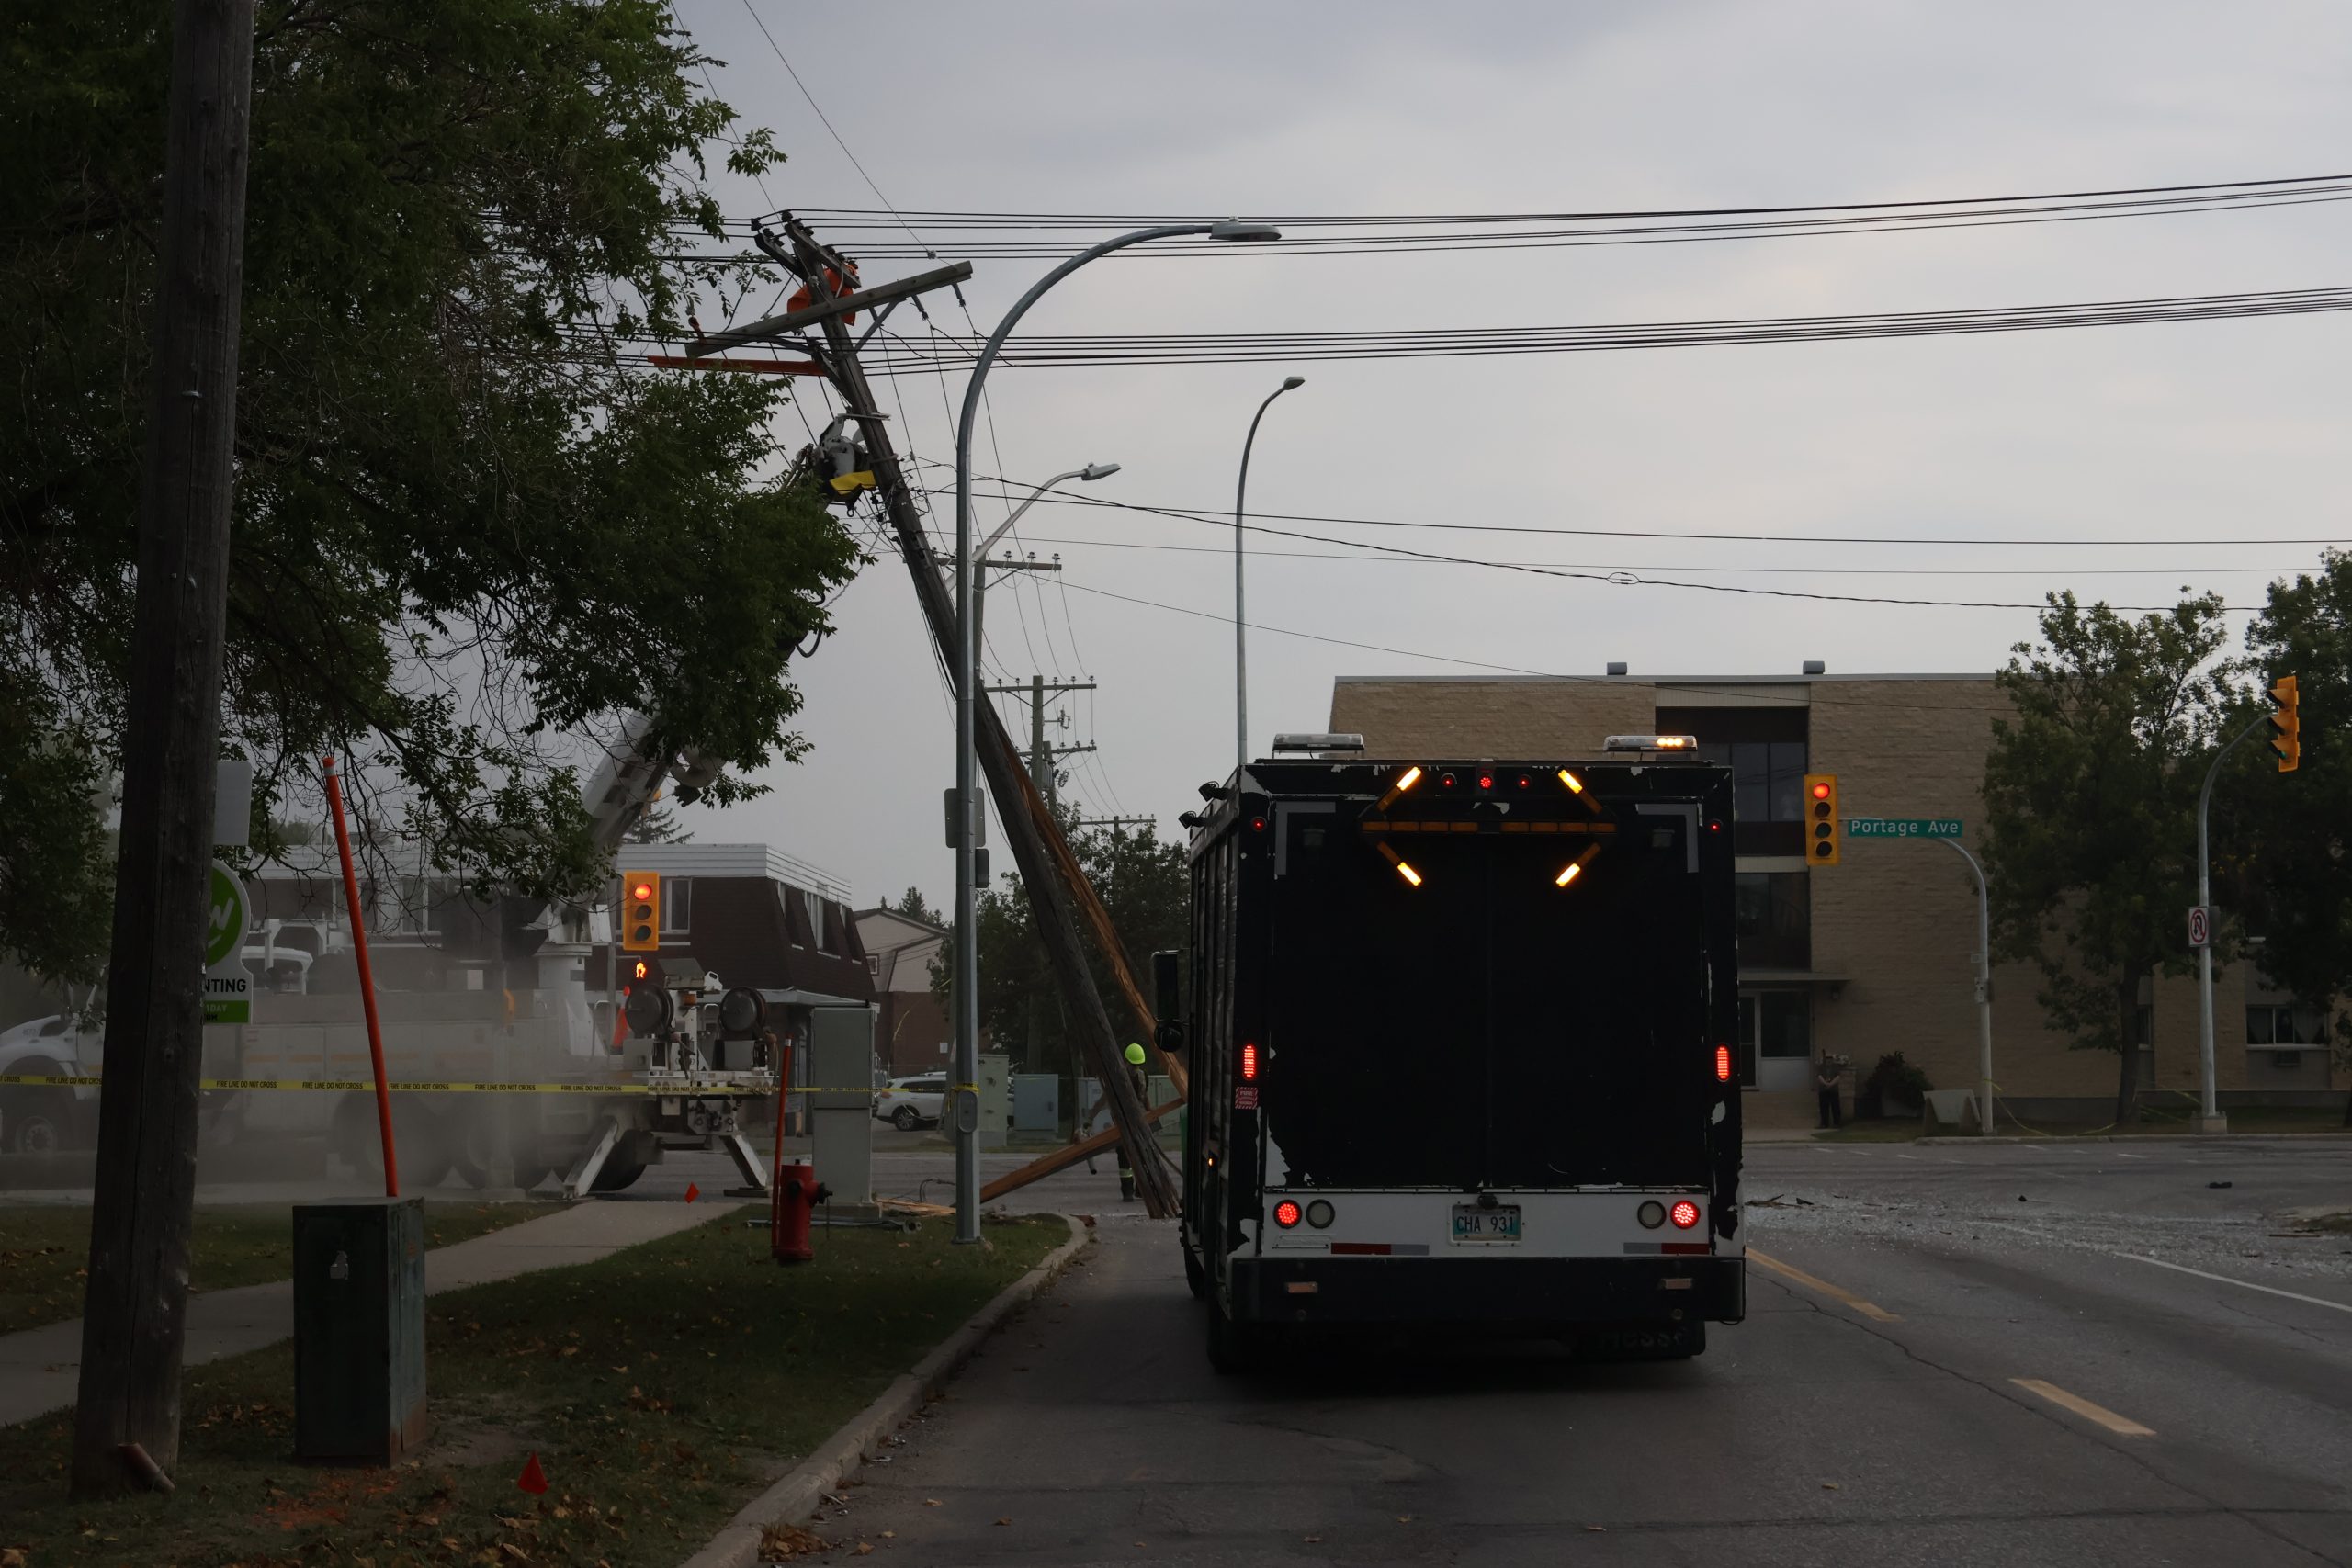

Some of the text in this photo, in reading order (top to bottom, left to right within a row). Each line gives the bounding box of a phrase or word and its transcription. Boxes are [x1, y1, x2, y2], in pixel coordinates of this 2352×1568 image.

[1851, 820, 1959, 837] Portage Ave
[205, 978, 246, 993] NTING
[1456, 1216, 1513, 1233] CHA 931
